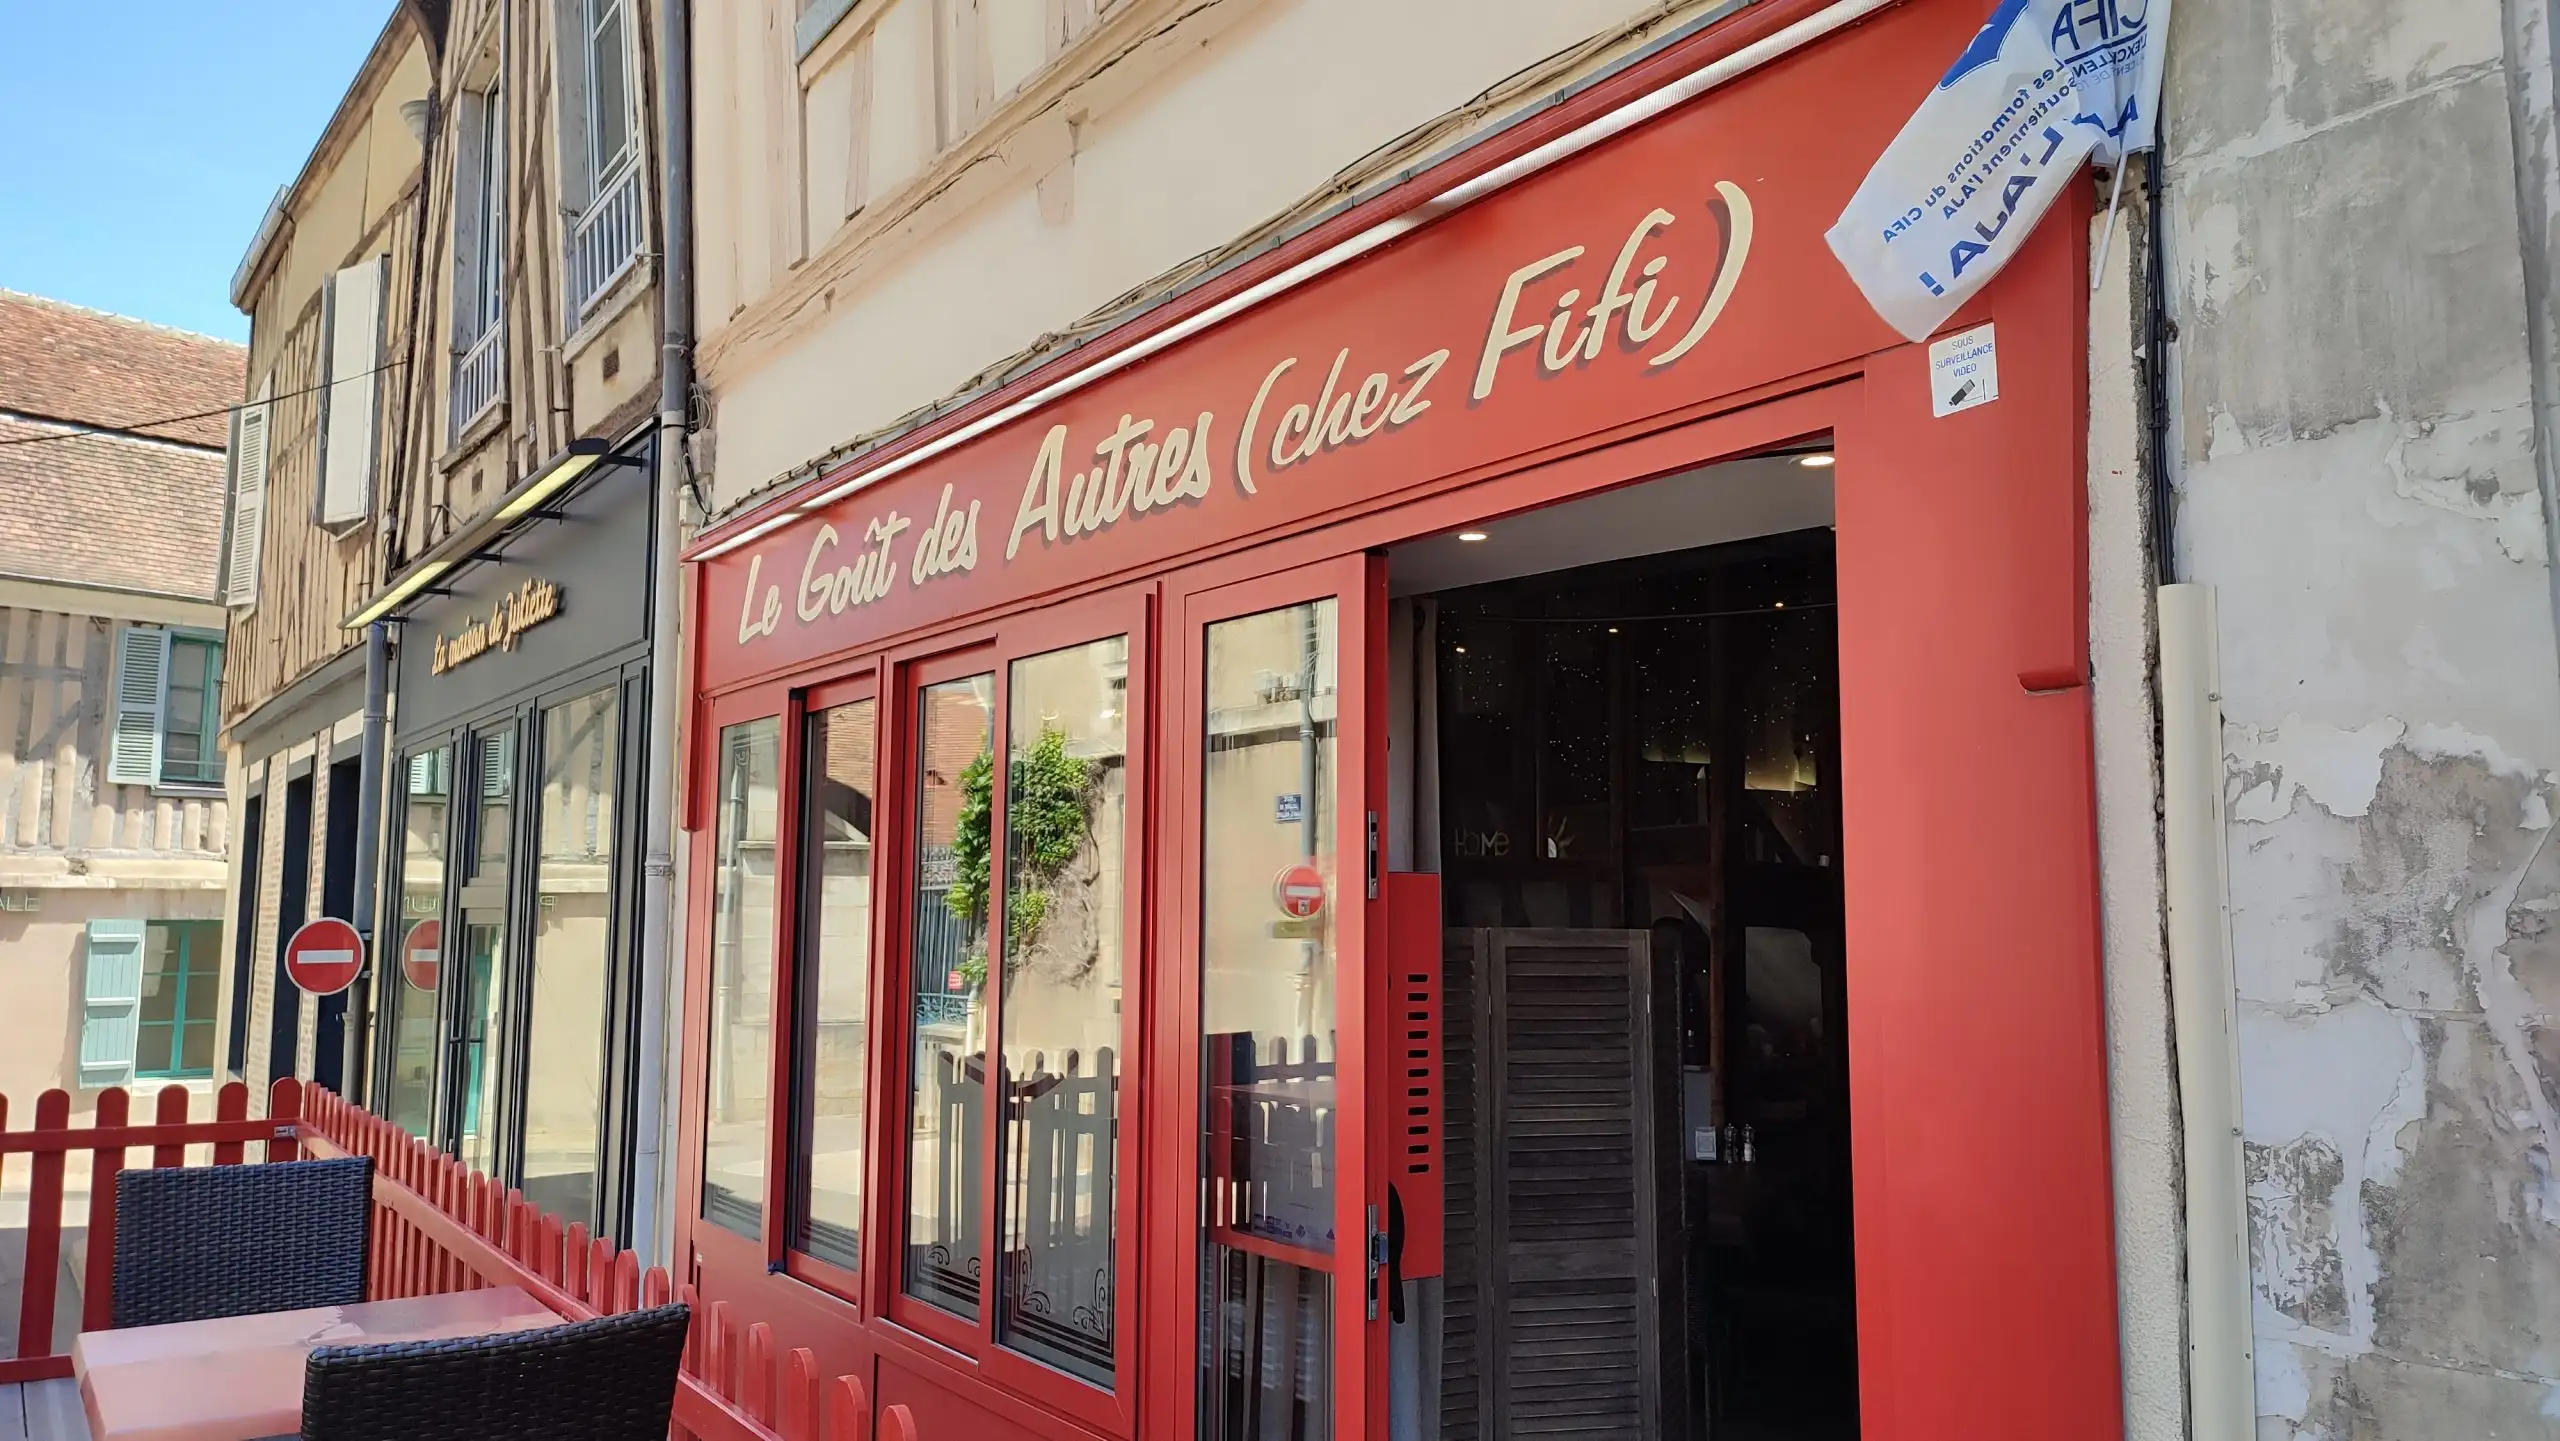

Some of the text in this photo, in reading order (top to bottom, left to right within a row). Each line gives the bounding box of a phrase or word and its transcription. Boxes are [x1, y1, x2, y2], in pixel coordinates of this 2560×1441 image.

[1935, 343, 1993, 370] SURVEILLANCE
[1952, 335, 1974, 351] SOUS
[1953, 363, 1977, 377] VIDEO
[738, 180, 1754, 645] Le Goût des Autres (chez Fifi)
[432, 577, 558, 677] La maison de Juliette
